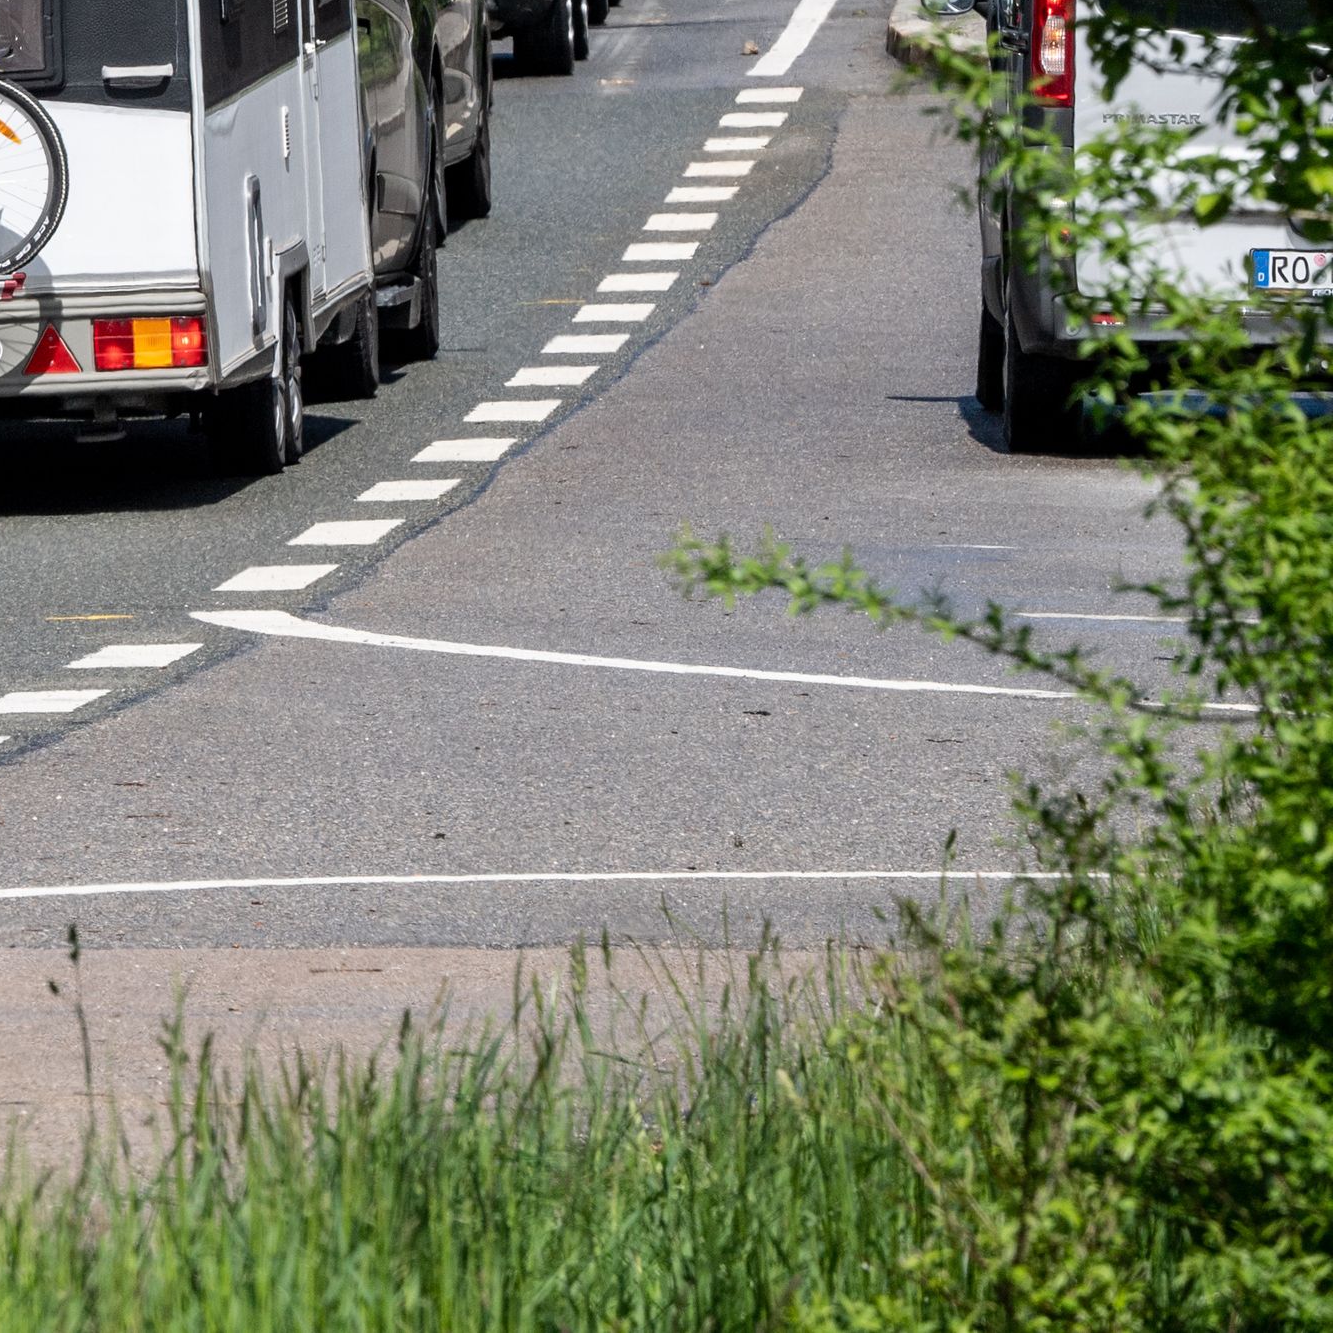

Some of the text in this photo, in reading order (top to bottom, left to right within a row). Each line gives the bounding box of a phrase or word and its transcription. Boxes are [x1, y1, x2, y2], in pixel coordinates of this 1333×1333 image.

[33, 215, 50, 243] ACE
[1257, 272, 1265, 282] D
[1271, 256, 1310, 284] RO
